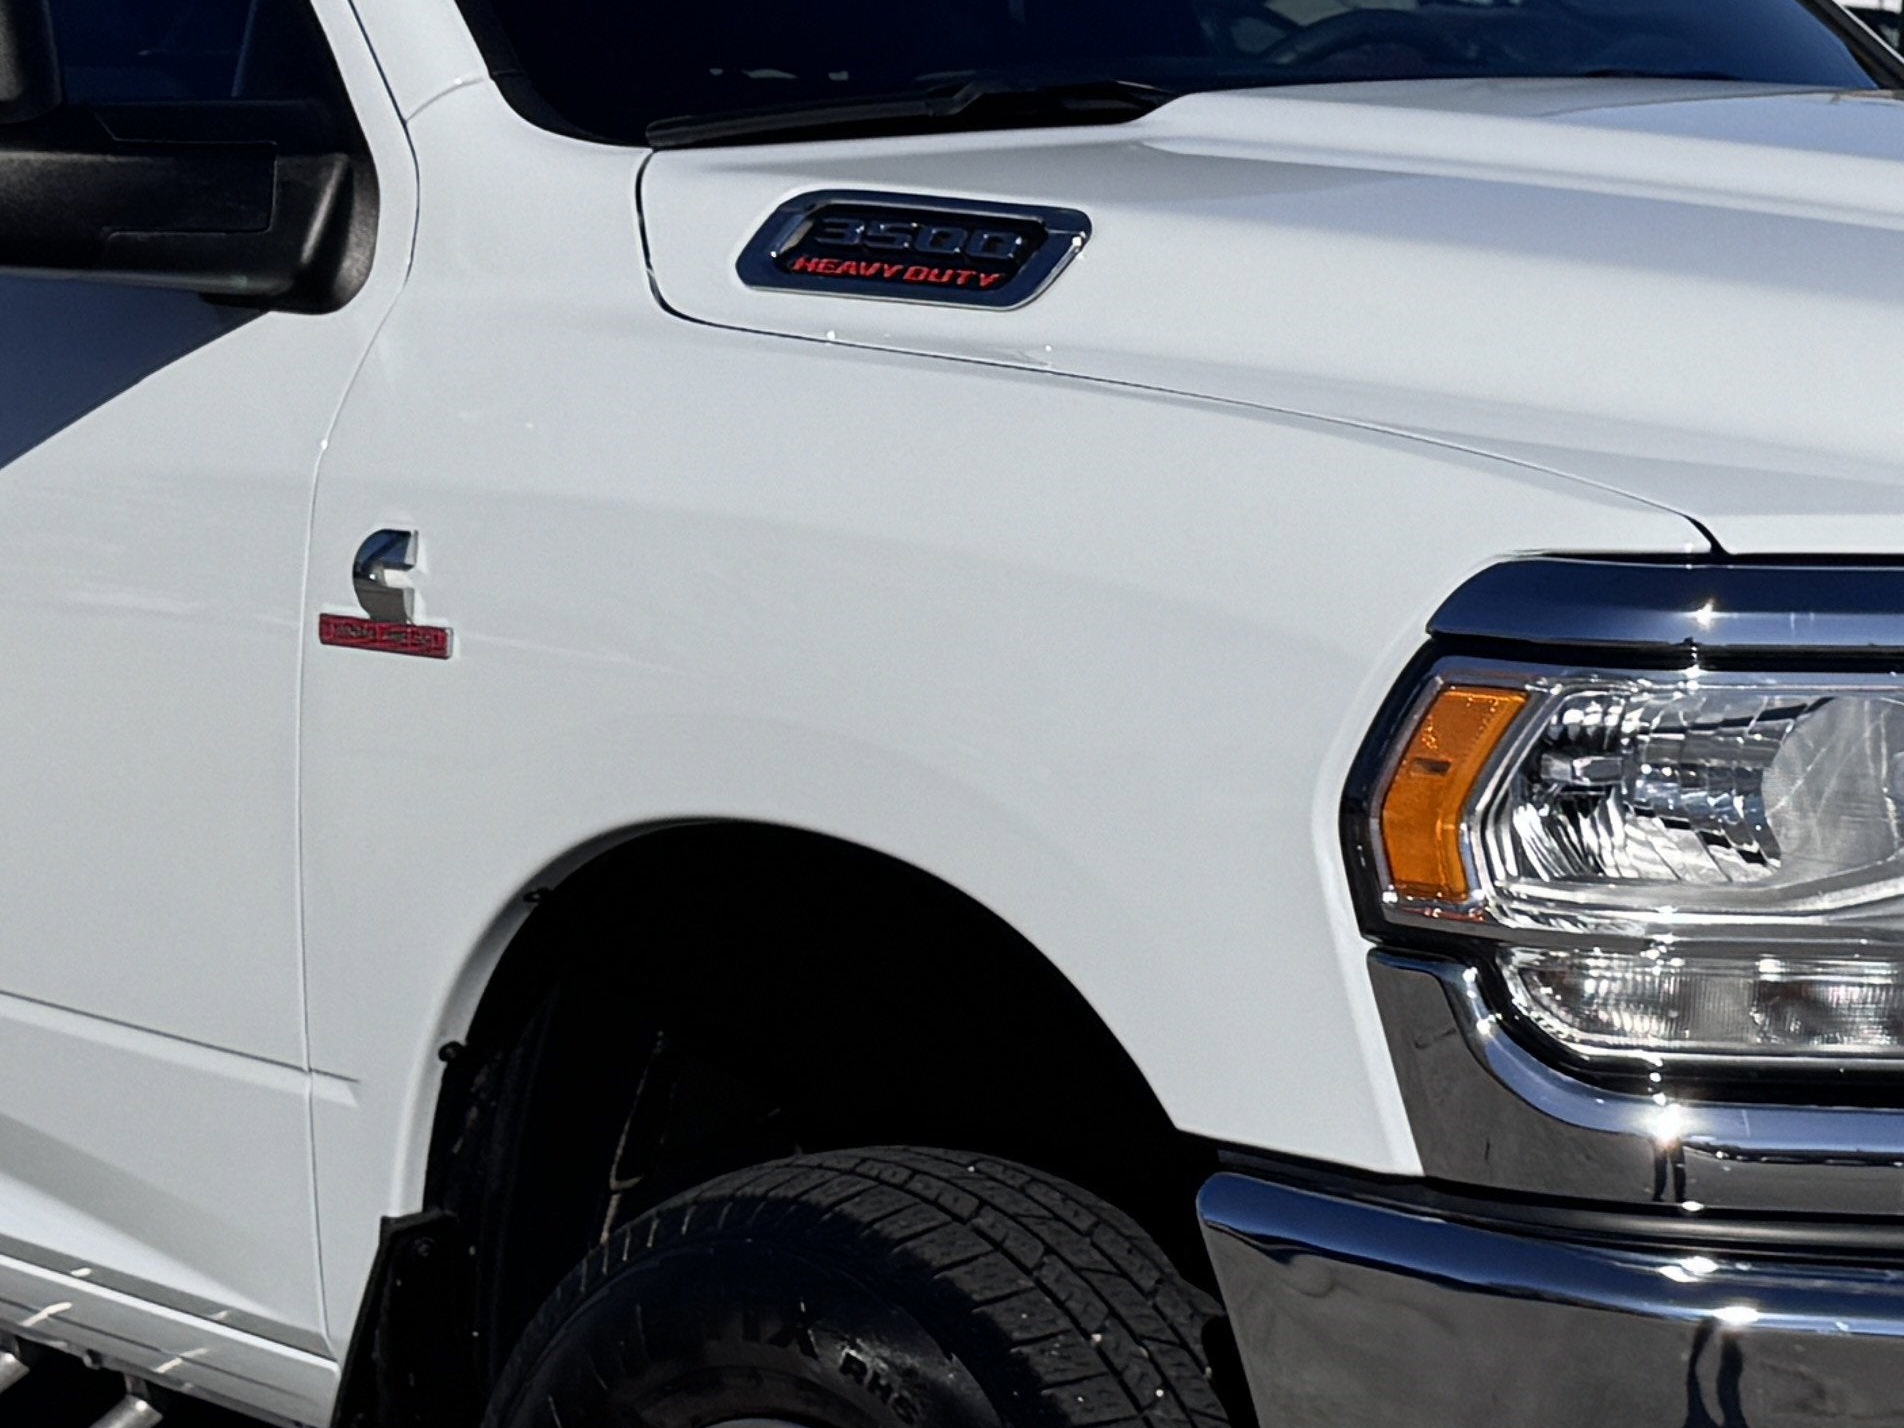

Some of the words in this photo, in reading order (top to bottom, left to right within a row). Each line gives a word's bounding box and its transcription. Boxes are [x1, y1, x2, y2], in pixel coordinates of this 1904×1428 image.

[813, 216, 1022, 260] 3500
[792, 256, 903, 280] HEAVY
[902, 264, 1000, 288] DUTY
